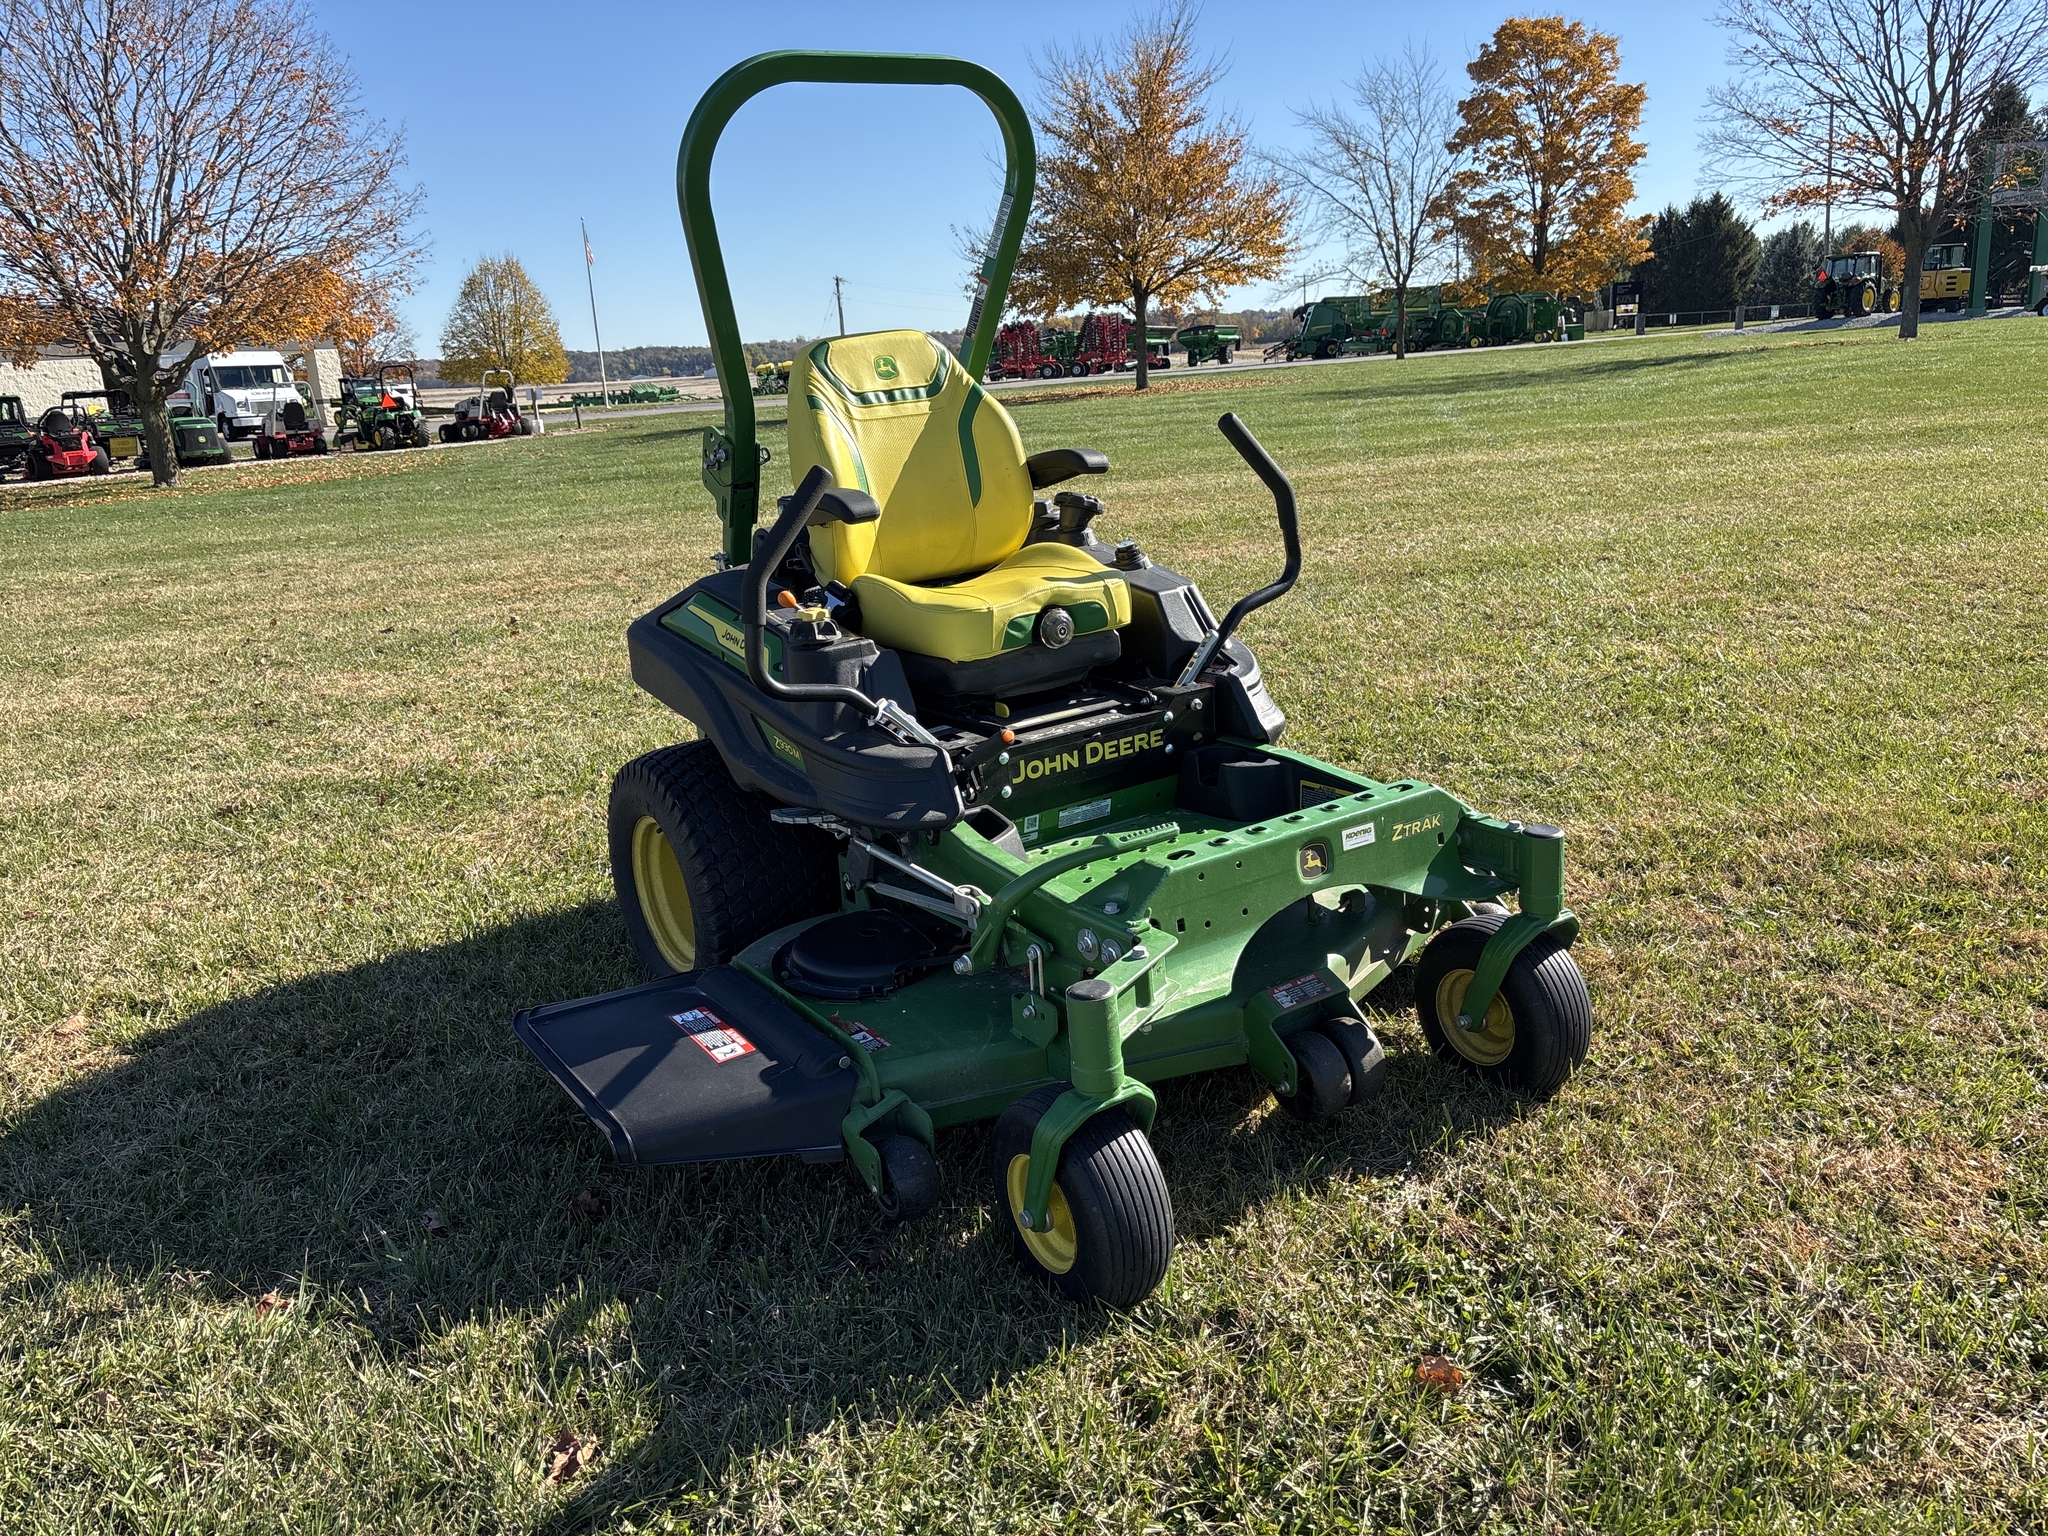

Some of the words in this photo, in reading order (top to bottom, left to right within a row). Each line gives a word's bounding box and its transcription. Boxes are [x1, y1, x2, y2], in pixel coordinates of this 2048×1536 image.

[721, 629, 740, 648] JOHN
[773, 735, 801, 761] Z930M
[1012, 750, 1079, 784] JOHN
[1085, 728, 1164, 765] DEERE
[1392, 814, 1441, 841] ZTRAK
